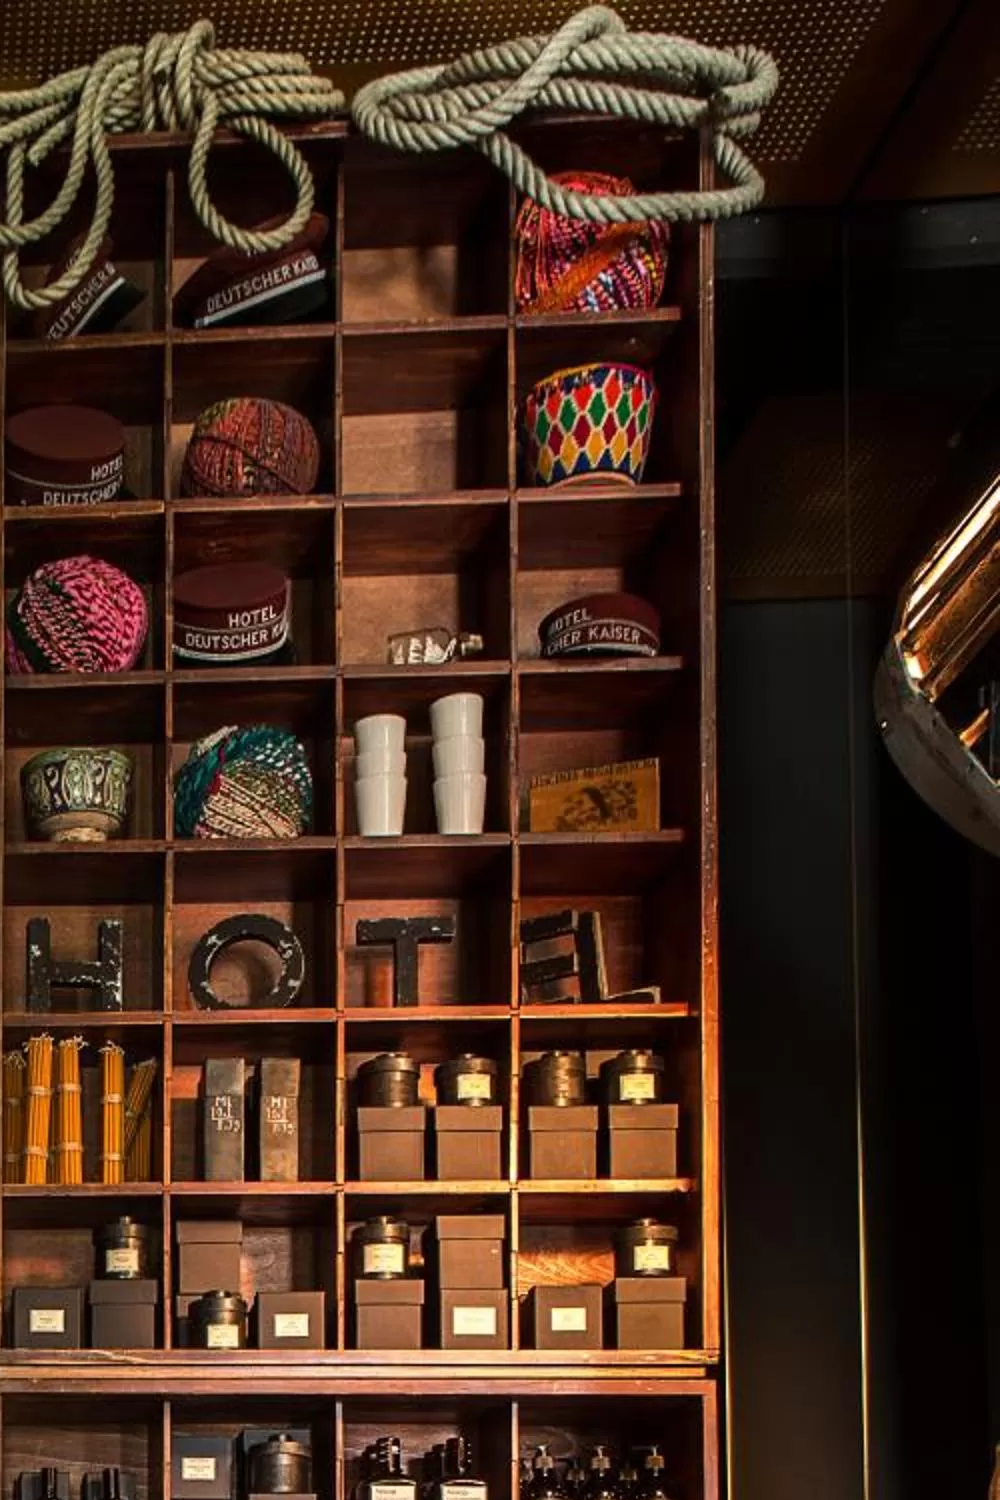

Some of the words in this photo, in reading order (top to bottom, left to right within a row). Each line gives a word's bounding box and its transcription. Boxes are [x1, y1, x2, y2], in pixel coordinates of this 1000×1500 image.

[228, 604, 278, 629] HOTEL
[185, 630, 269, 650] DEUTSCHER
[587, 625, 641, 645] KAISER
